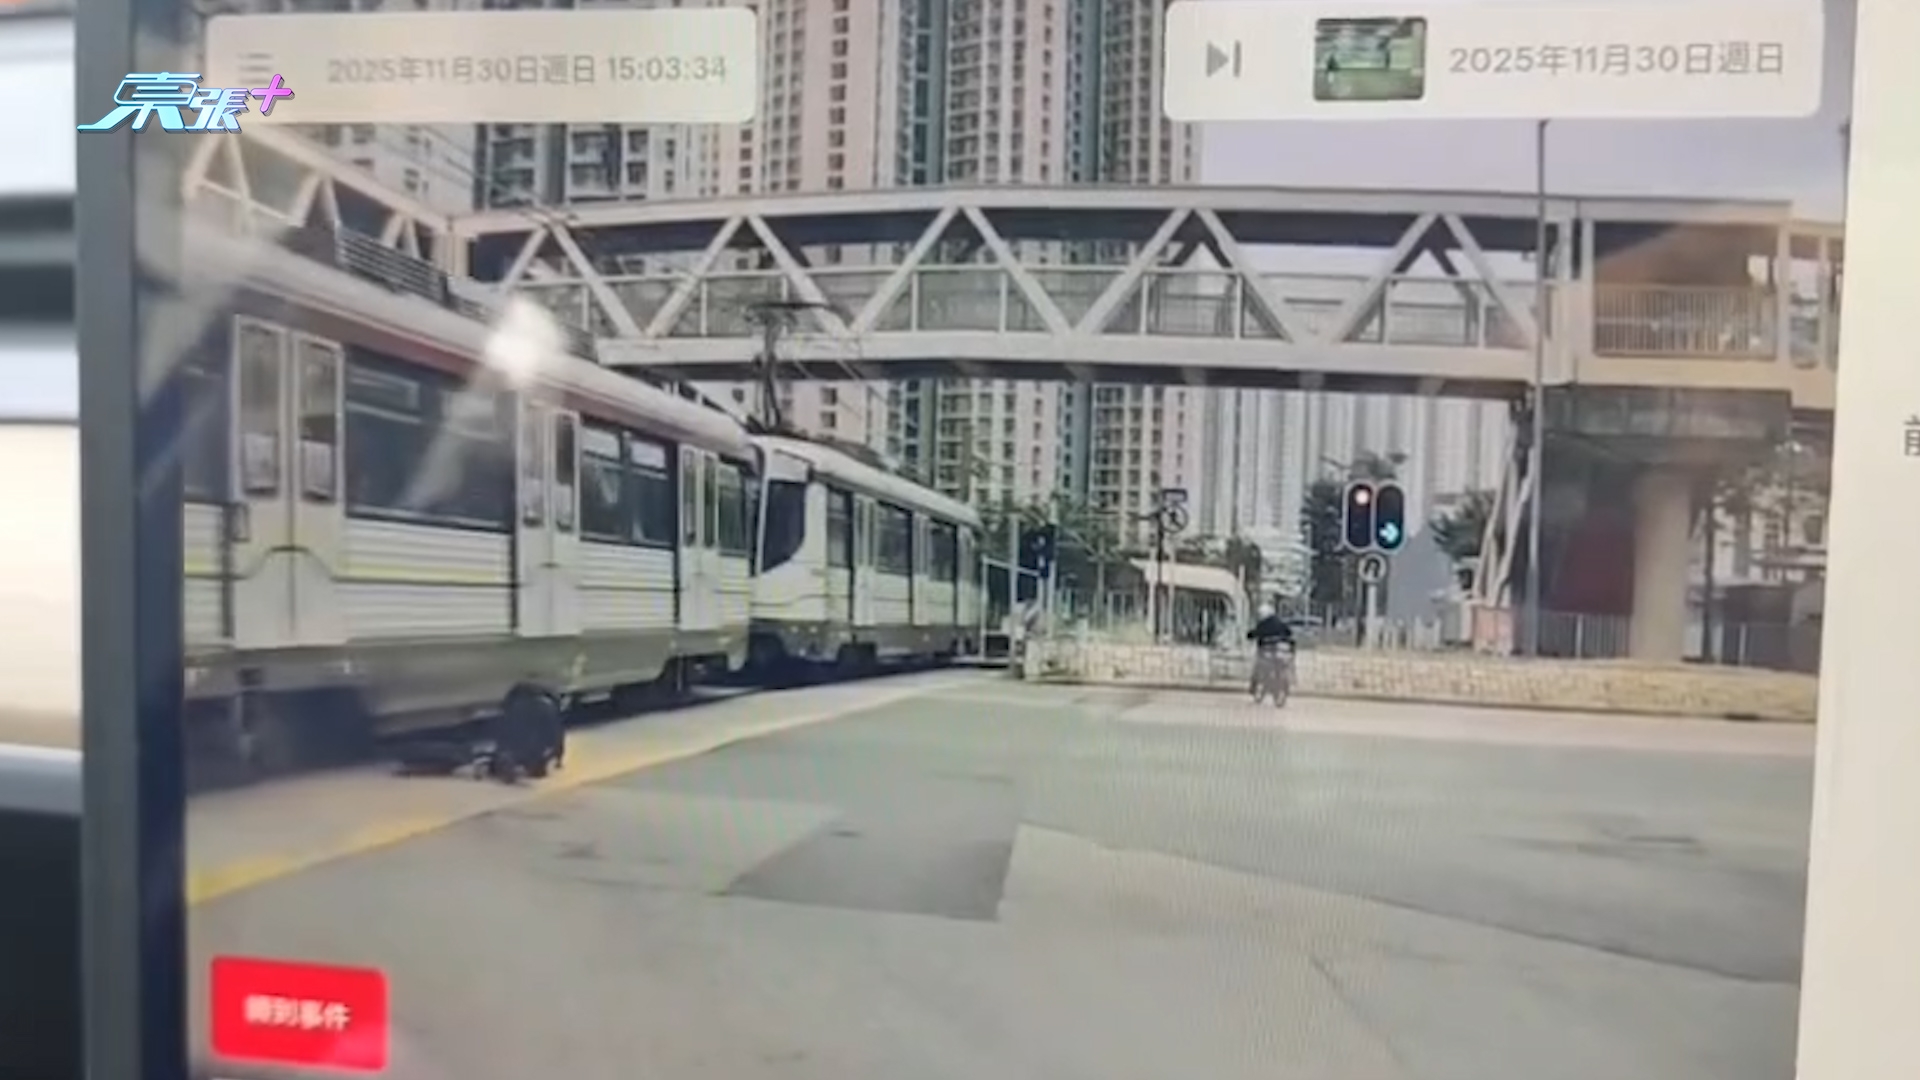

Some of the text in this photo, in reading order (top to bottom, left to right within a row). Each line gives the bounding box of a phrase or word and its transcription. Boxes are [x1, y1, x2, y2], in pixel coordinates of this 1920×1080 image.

[607, 56, 728, 83] 15:03:34
[1448, 41, 1785, 76] 2025年11月30日週日
